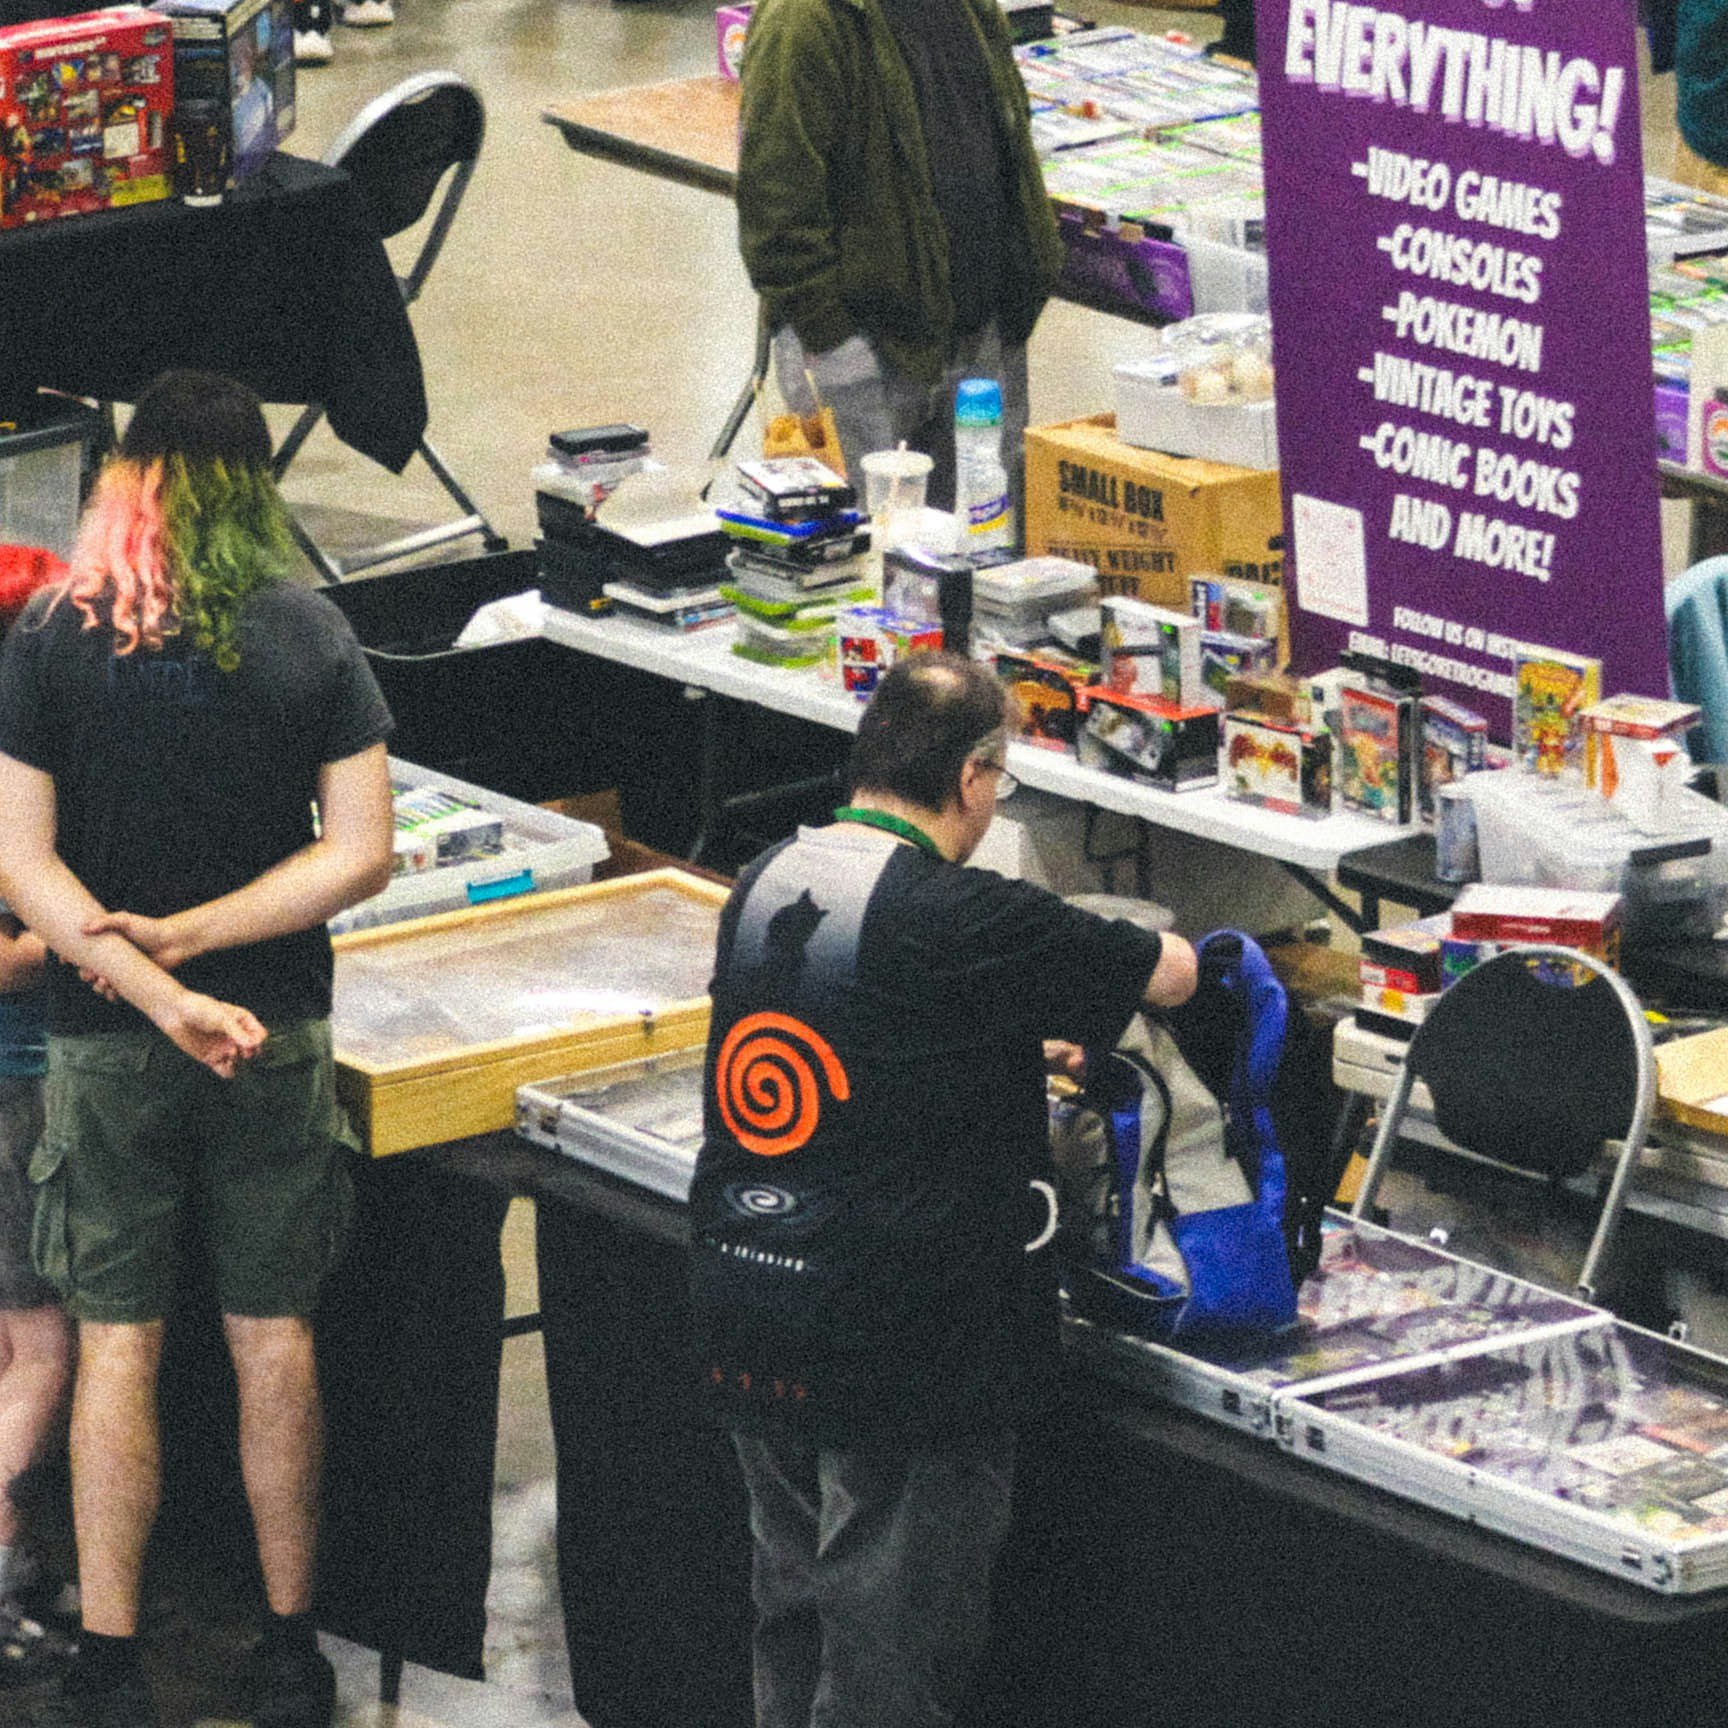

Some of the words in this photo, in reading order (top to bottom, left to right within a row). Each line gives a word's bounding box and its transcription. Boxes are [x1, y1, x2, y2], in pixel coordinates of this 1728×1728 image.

[1455, 174, 1562, 240] GAMES
[1498, 390, 1576, 450] TOYS
[1059, 459, 1119, 508] SMALL
[1124, 480, 1165, 522] BOX
[1474, 449, 1582, 520] BOOKS
[1389, 493, 1451, 552] AND
[1455, 510, 1556, 582] MORE!
